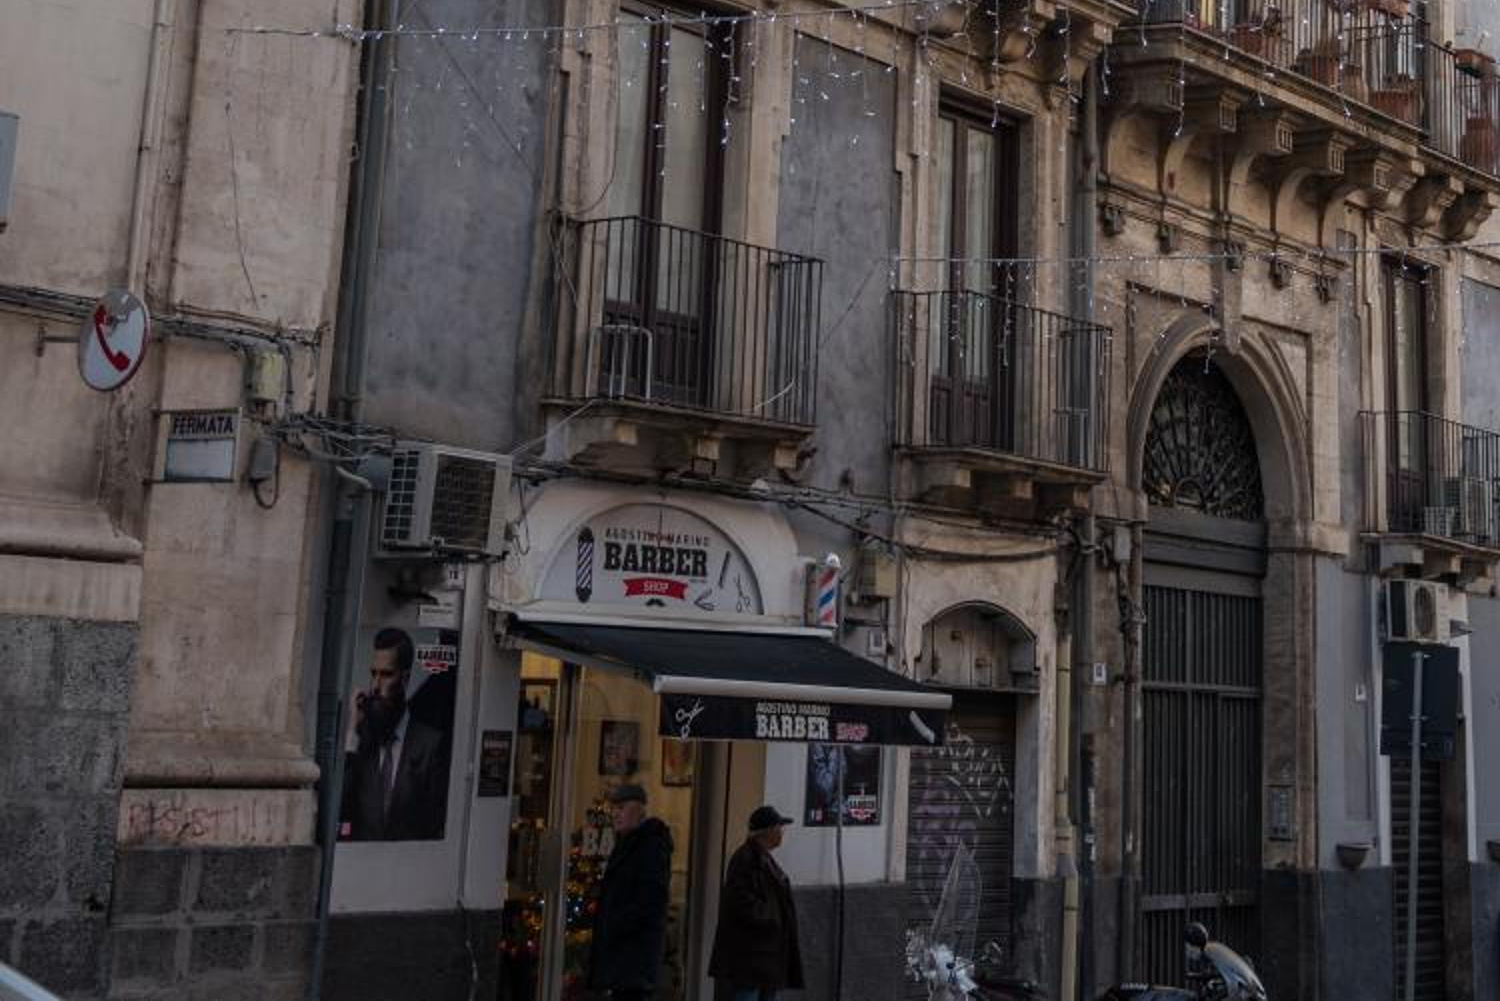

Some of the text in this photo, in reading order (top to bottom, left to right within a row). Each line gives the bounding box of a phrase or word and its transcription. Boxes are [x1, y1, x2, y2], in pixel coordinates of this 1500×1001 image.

[174, 414, 233, 434] FERMATA
[604, 542, 707, 577] BARBER
[643, 581, 669, 593] SHOP
[755, 713, 869, 742] BARBER SHOP
